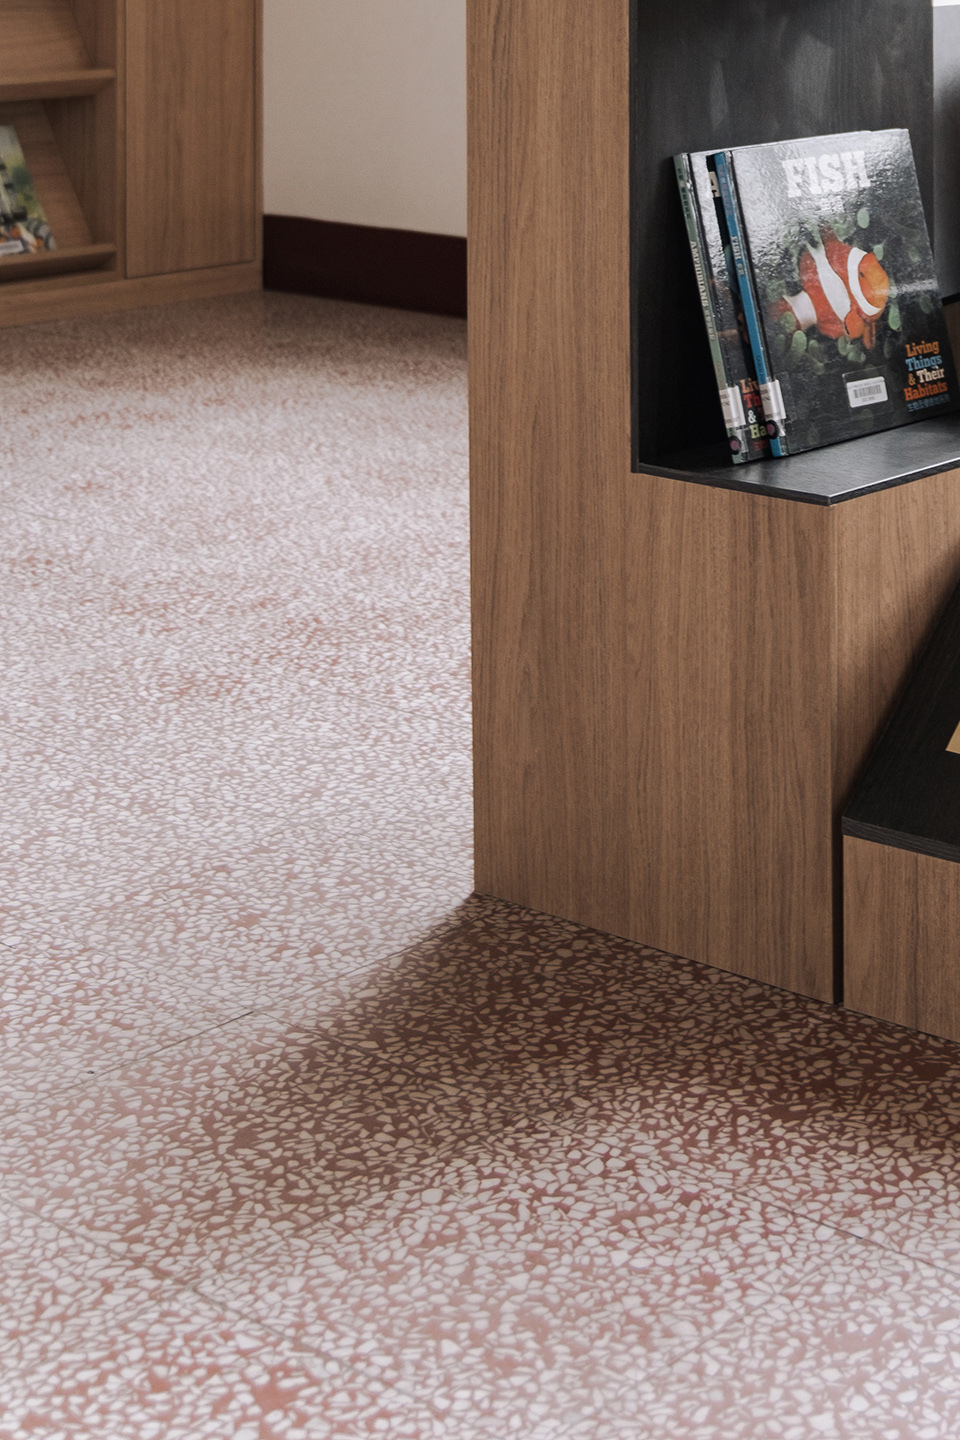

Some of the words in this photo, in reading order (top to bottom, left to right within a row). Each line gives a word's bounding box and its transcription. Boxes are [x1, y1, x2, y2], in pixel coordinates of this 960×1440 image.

[782, 150, 871, 198] FISH
[731, 236, 742, 260] FISH
[690, 240, 708, 308] AMPHIBIANS
[905, 341, 939, 357] Living
[905, 355, 942, 371] Things
[908, 373, 915, 385] &
[916, 366, 945, 383] Their
[904, 382, 947, 401] Habitats
[748, 410, 756, 423] &
